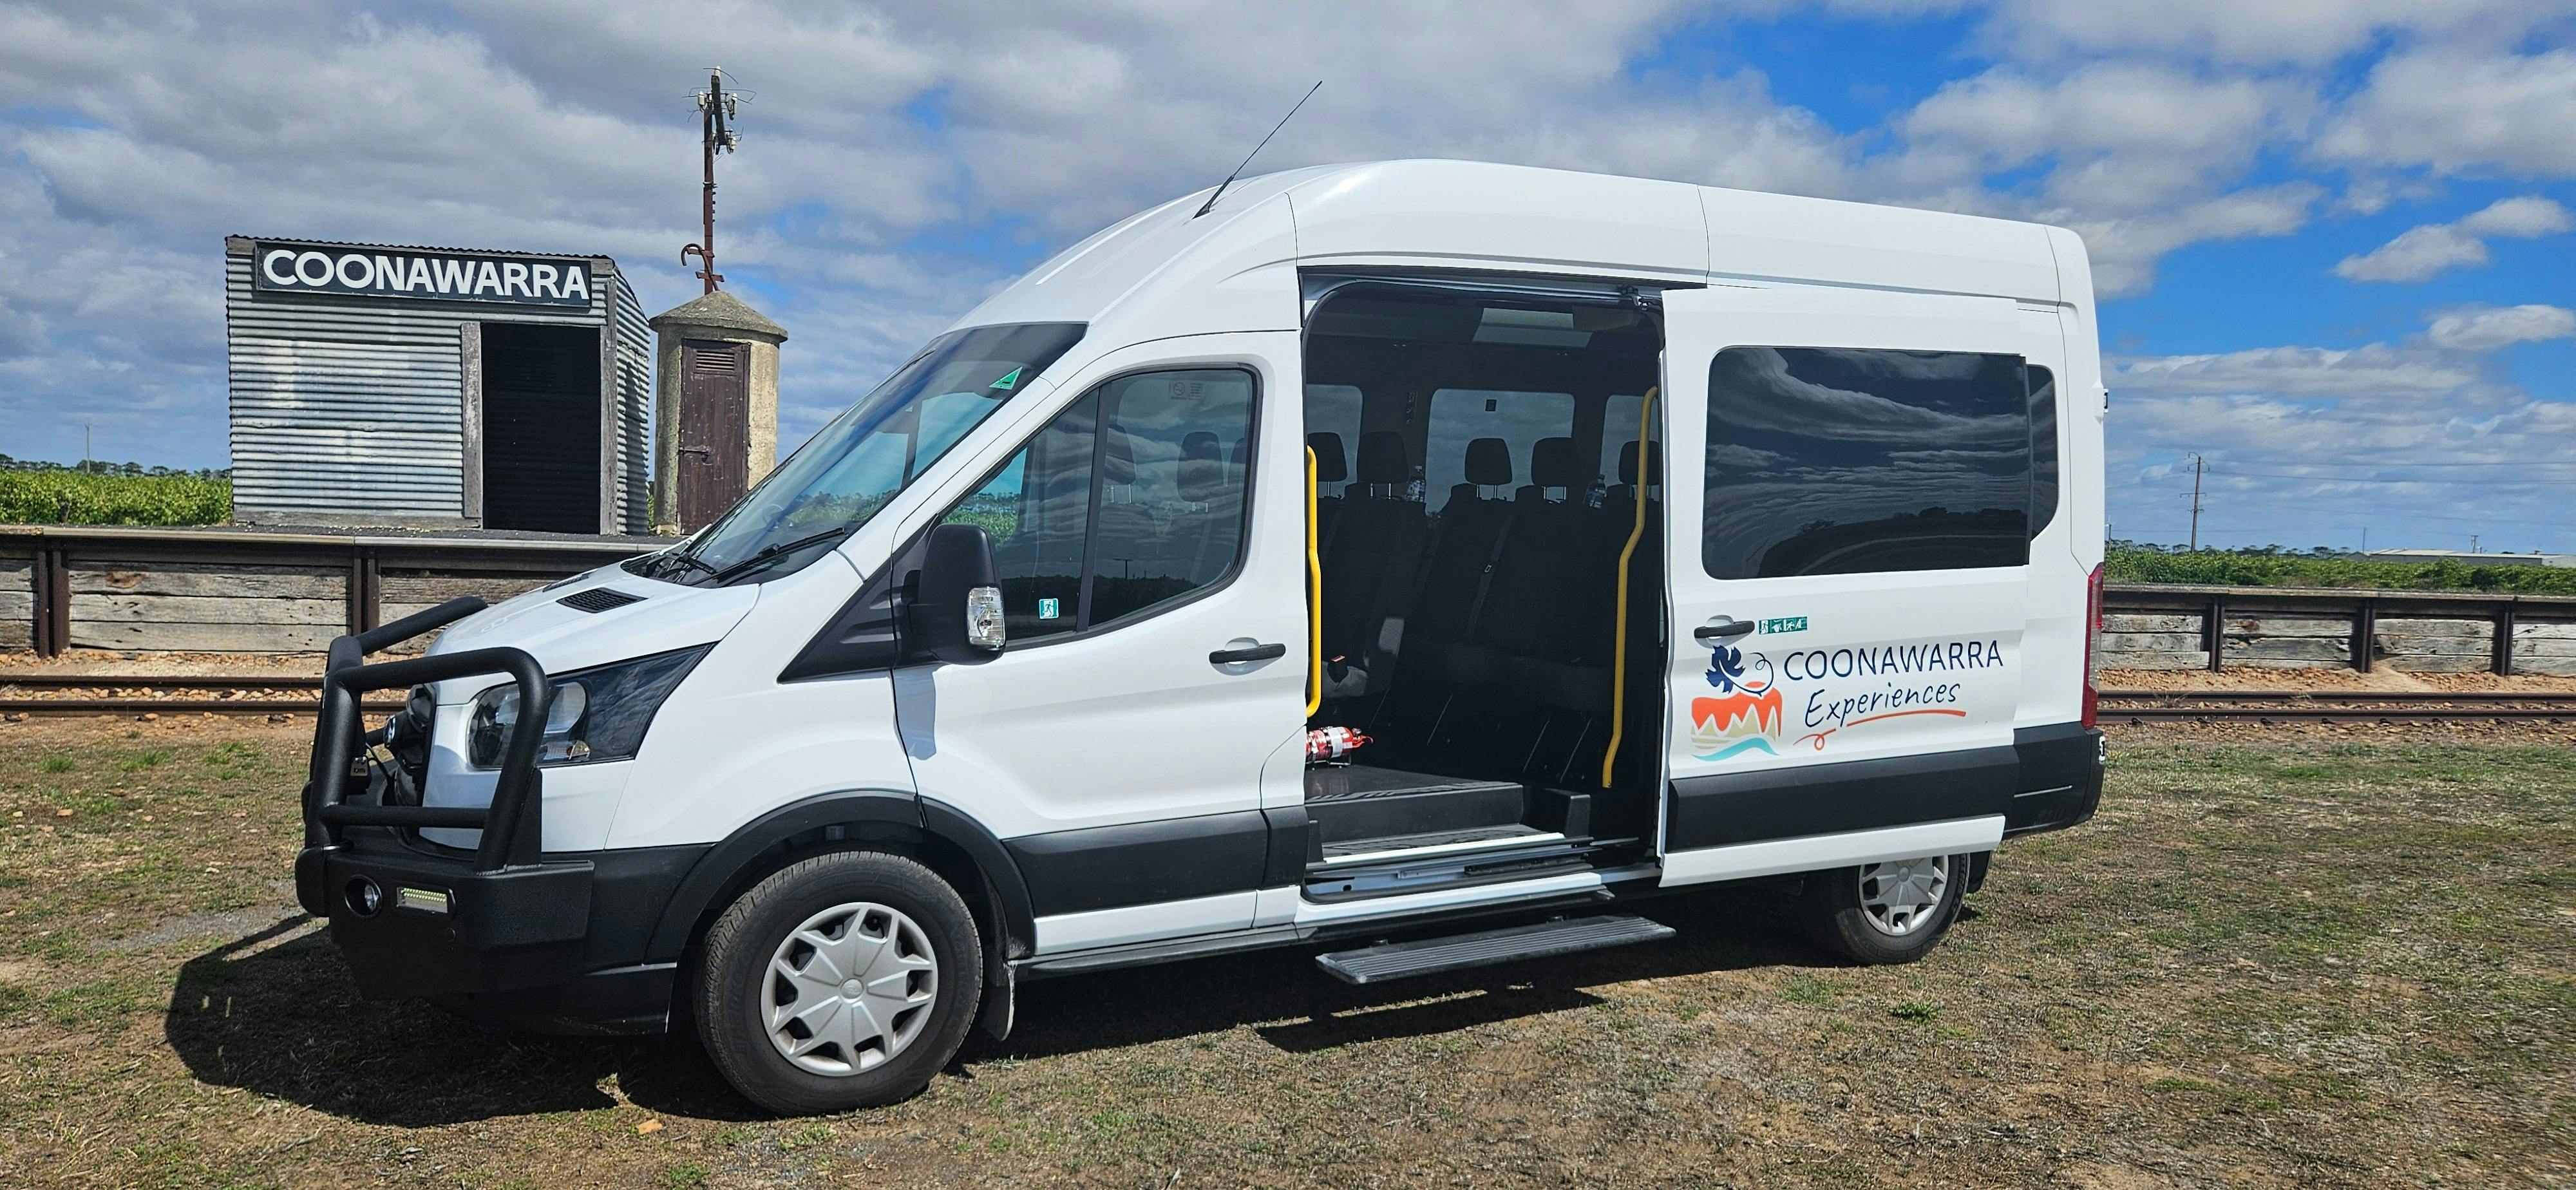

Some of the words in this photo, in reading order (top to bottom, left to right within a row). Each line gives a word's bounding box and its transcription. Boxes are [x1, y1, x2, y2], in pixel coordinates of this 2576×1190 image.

[263, 249, 589, 299] COONAWARRA
[1784, 640, 2003, 681] COONAWARRA
[1804, 682, 1960, 728] Experiences
